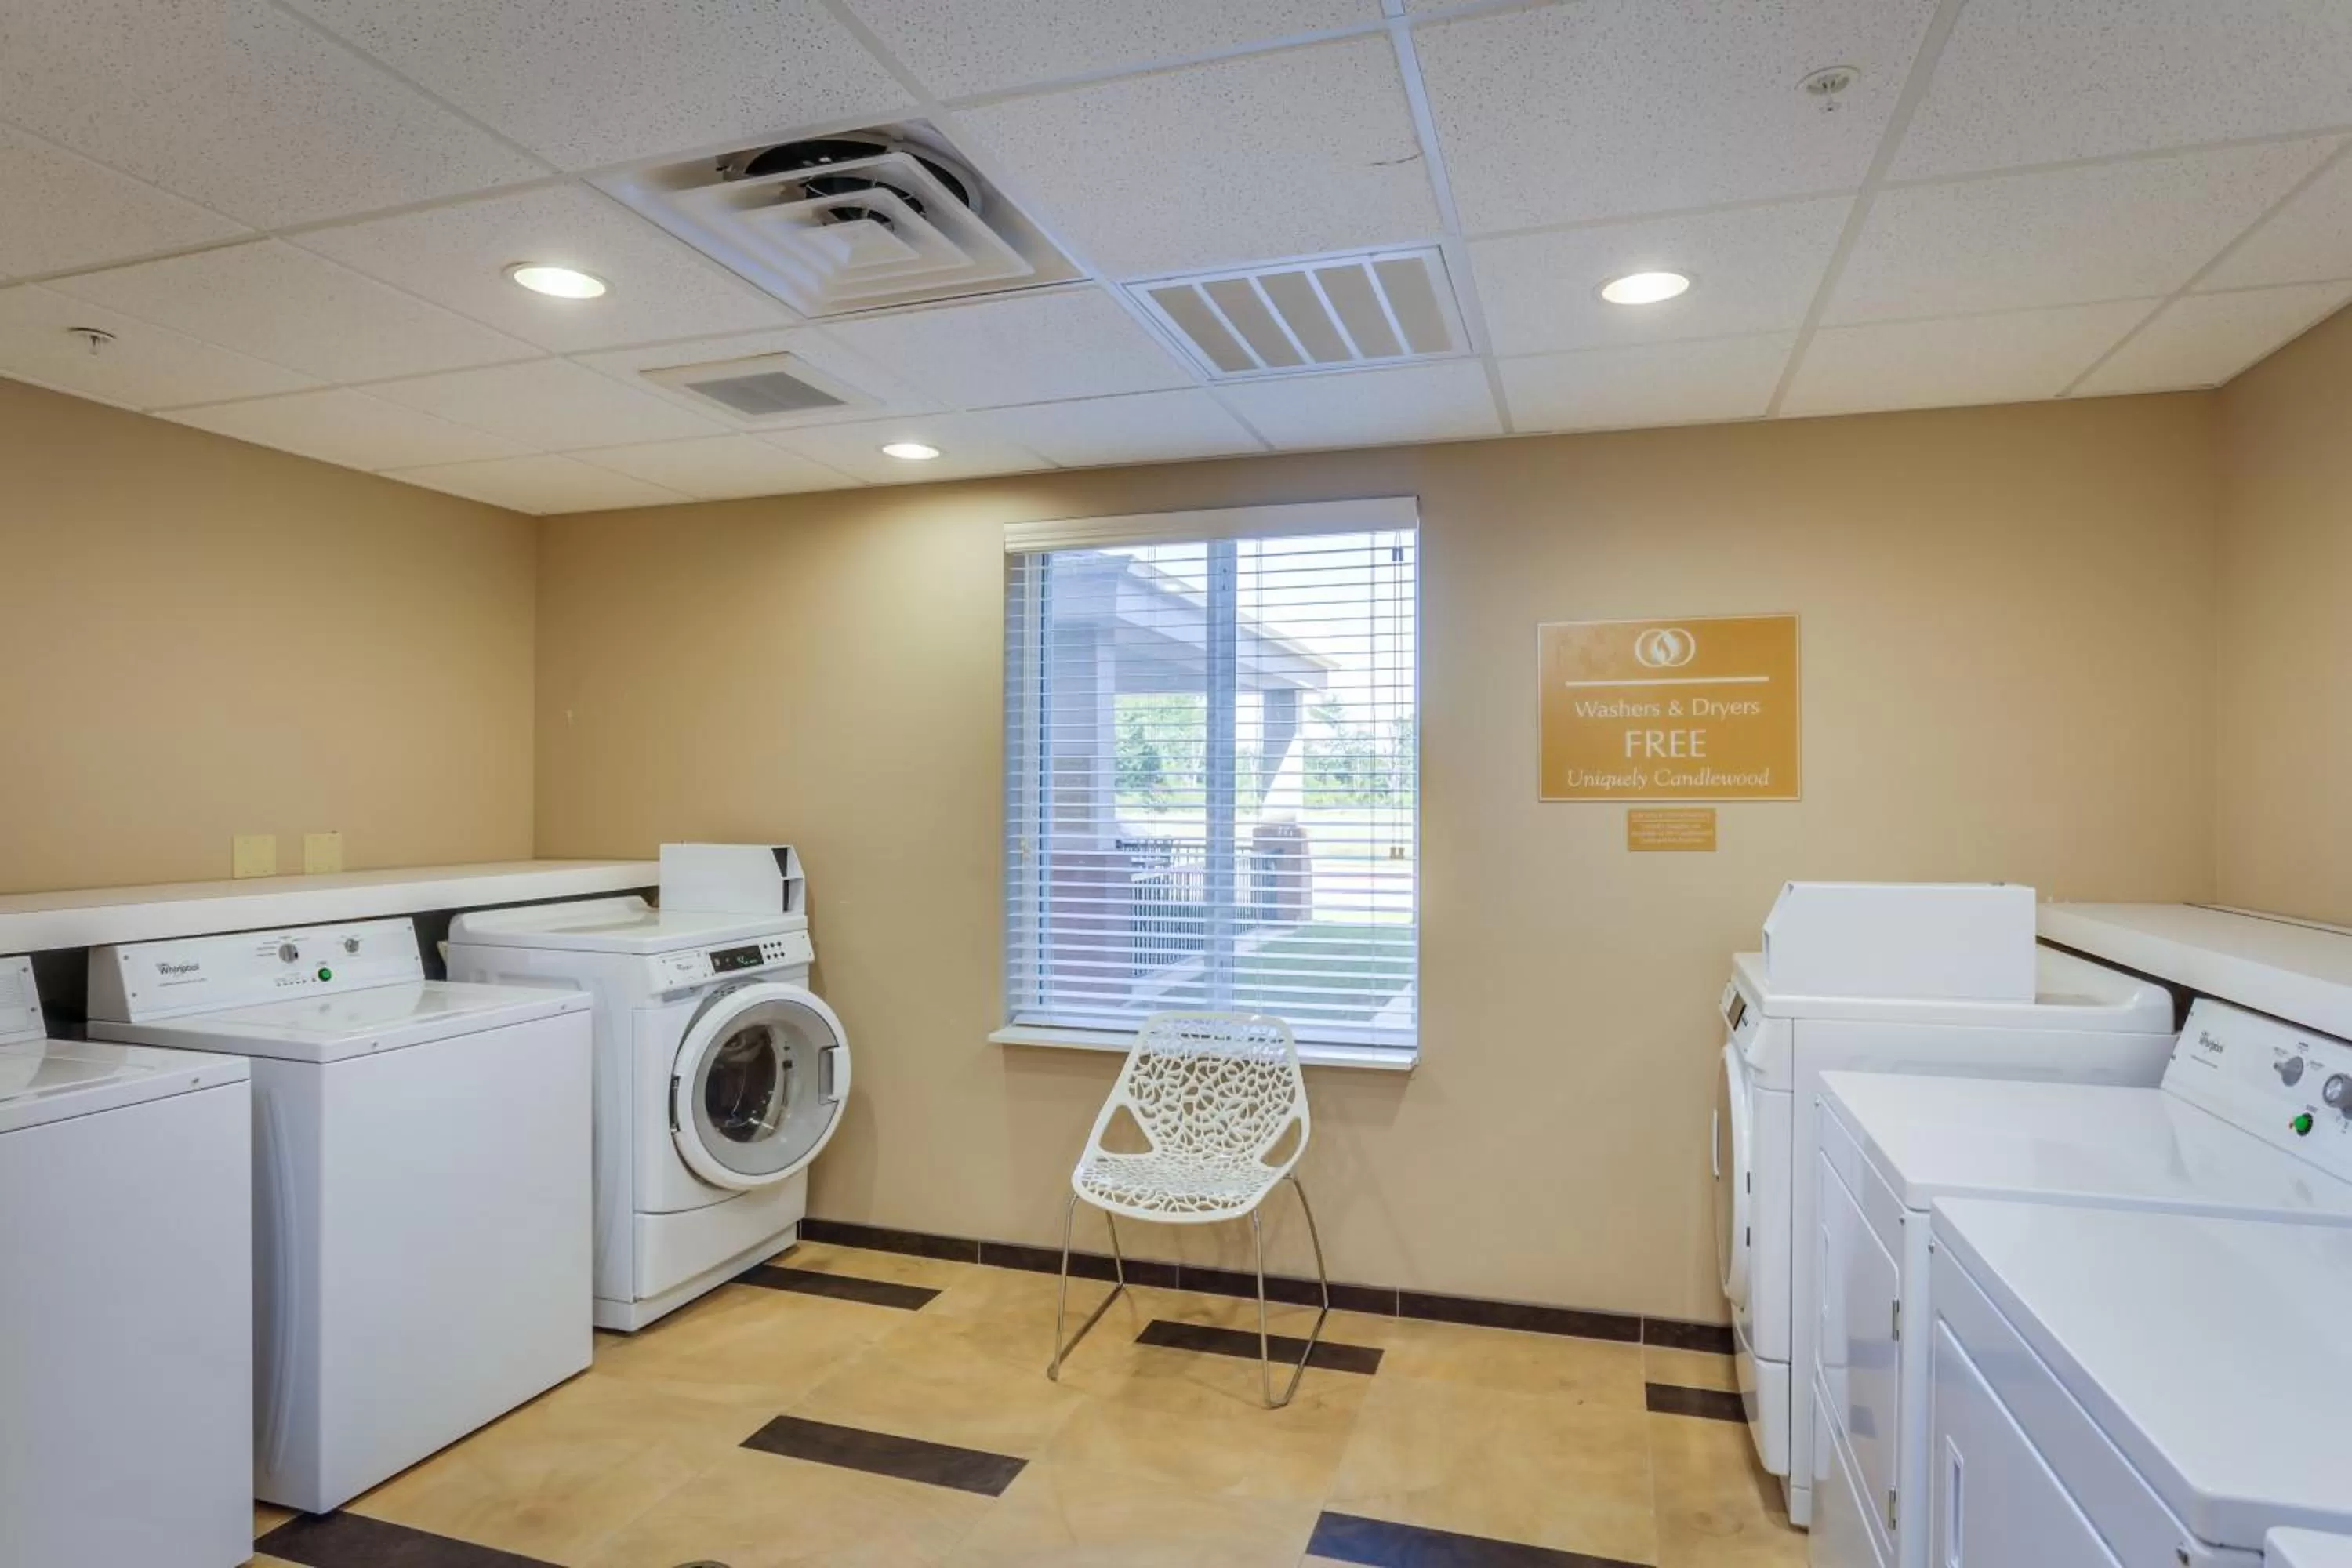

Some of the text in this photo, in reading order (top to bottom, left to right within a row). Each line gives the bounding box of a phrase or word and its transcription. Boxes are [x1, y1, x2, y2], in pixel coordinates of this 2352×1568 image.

[1575, 698, 1761, 721] Washers & Dryers
[1625, 729, 1707, 758] FREE
[1567, 768, 1770, 791] Uniquely Candlewood
